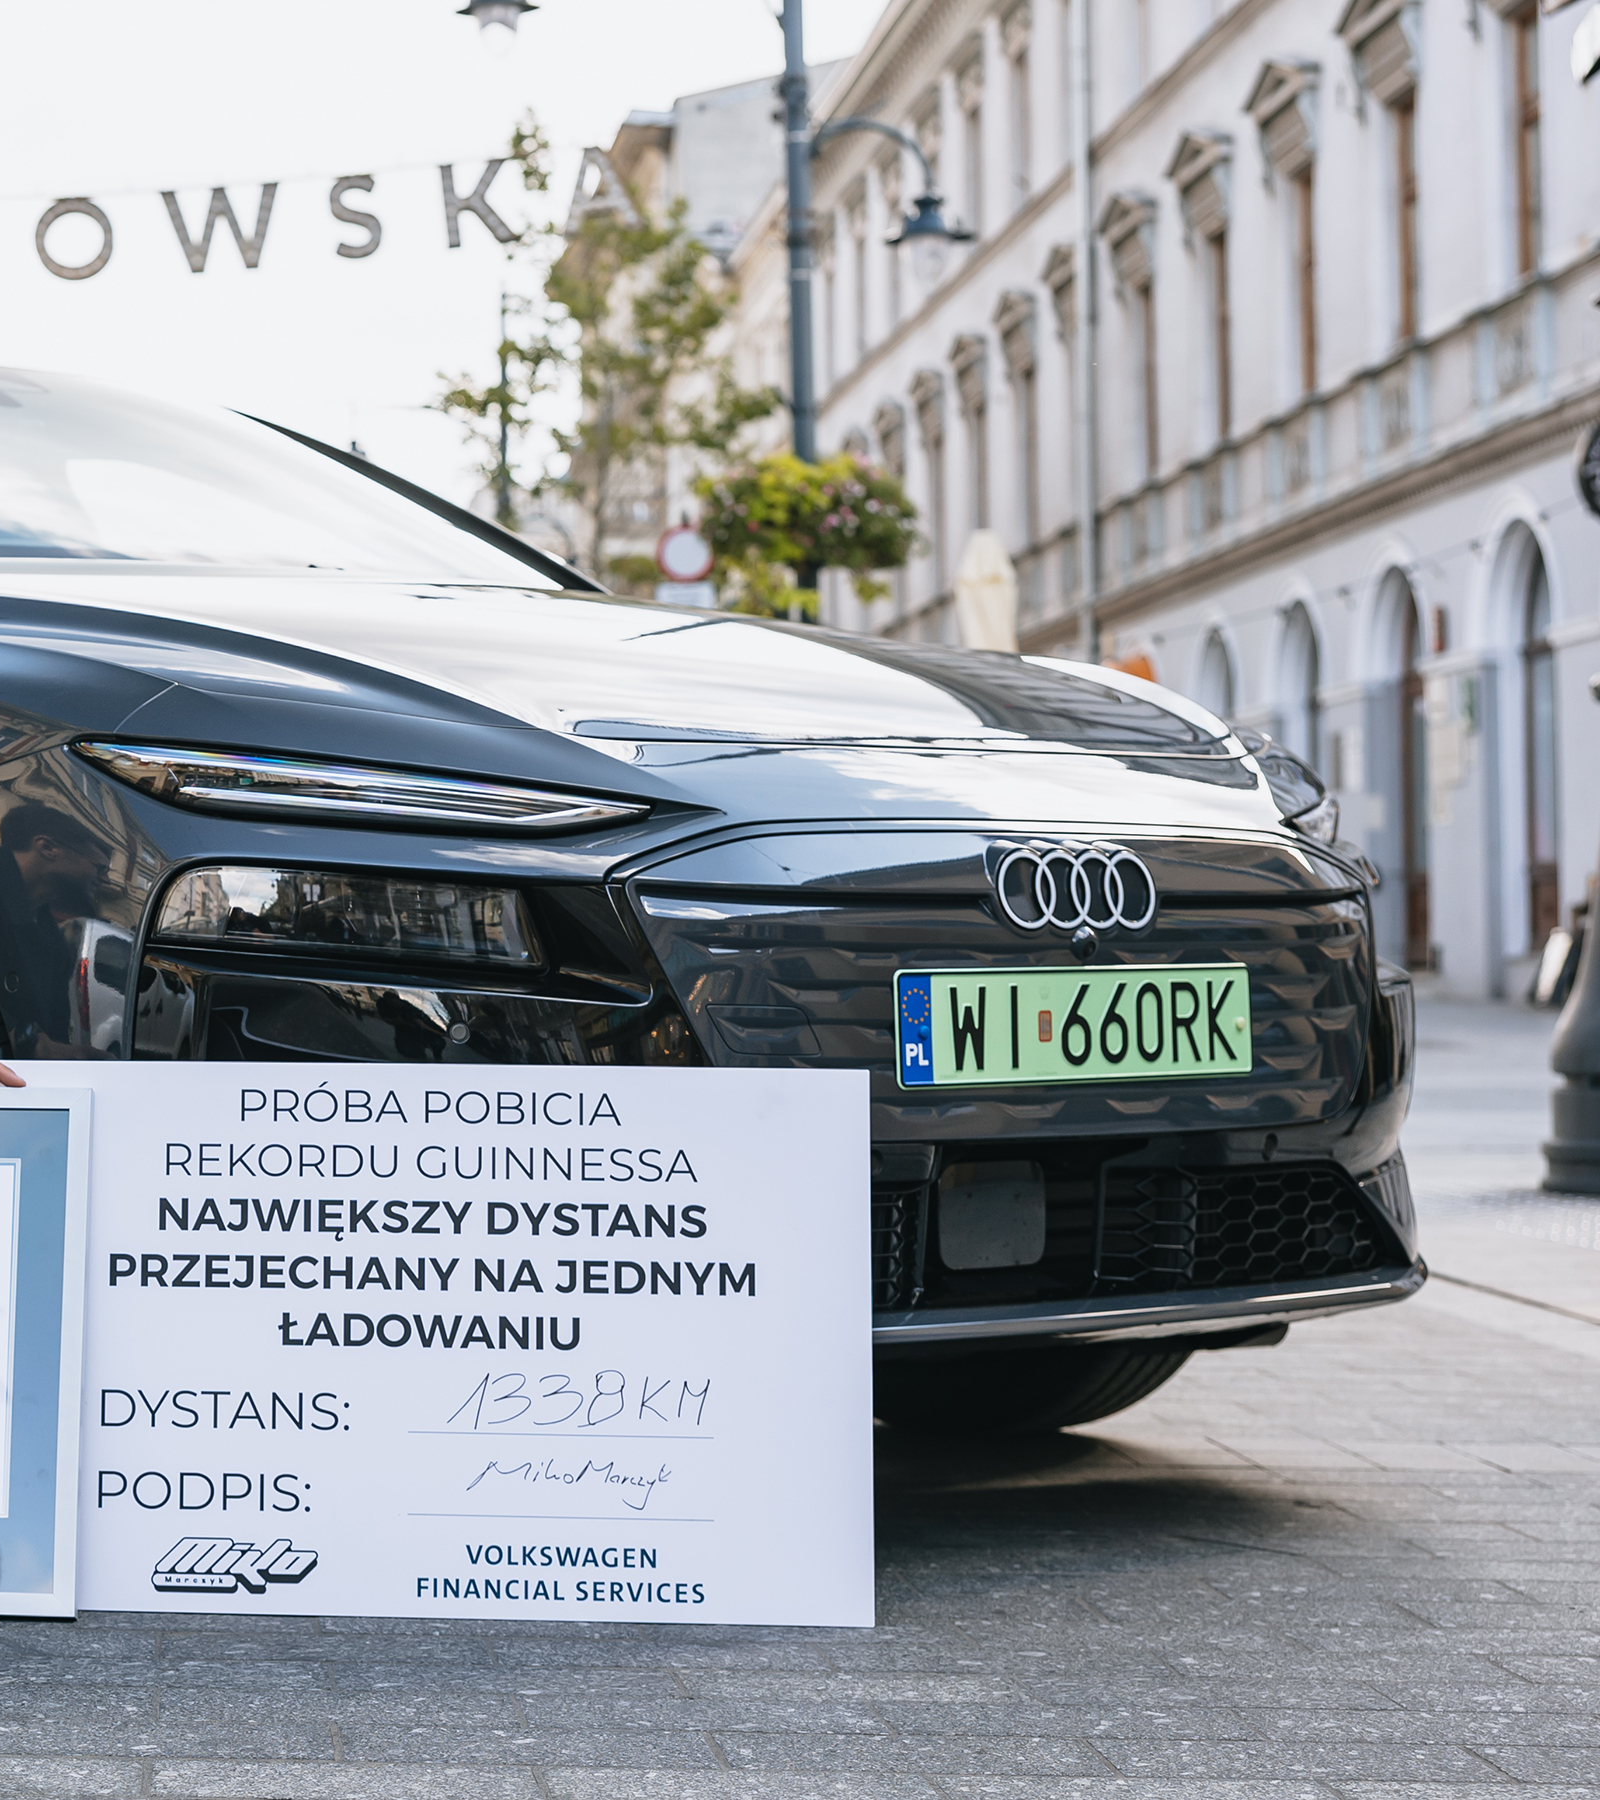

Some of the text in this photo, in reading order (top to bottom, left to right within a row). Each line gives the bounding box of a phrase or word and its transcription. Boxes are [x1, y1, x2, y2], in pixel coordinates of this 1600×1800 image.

[949, 979, 1238, 1072] WI 660RK
[905, 1042, 930, 1067] PL
[240, 1080, 622, 1127] PRÓBA POBICIA
[165, 1142, 698, 1183] REKORDU GUINNESSA
[158, 1197, 708, 1242] NAJWIĘKSZY DYSTANS
[109, 1253, 756, 1297] PRZEJECHANY NA JEDNYM
[277, 1311, 581, 1351] ŁADOWANIU
[100, 1388, 350, 1431] DYSTANS:
[97, 1470, 312, 1513] PODPIS:
[465, 1544, 658, 1569] VOLKSWAGEN
[416, 1577, 705, 1604] FINANCIAL SERVICES
